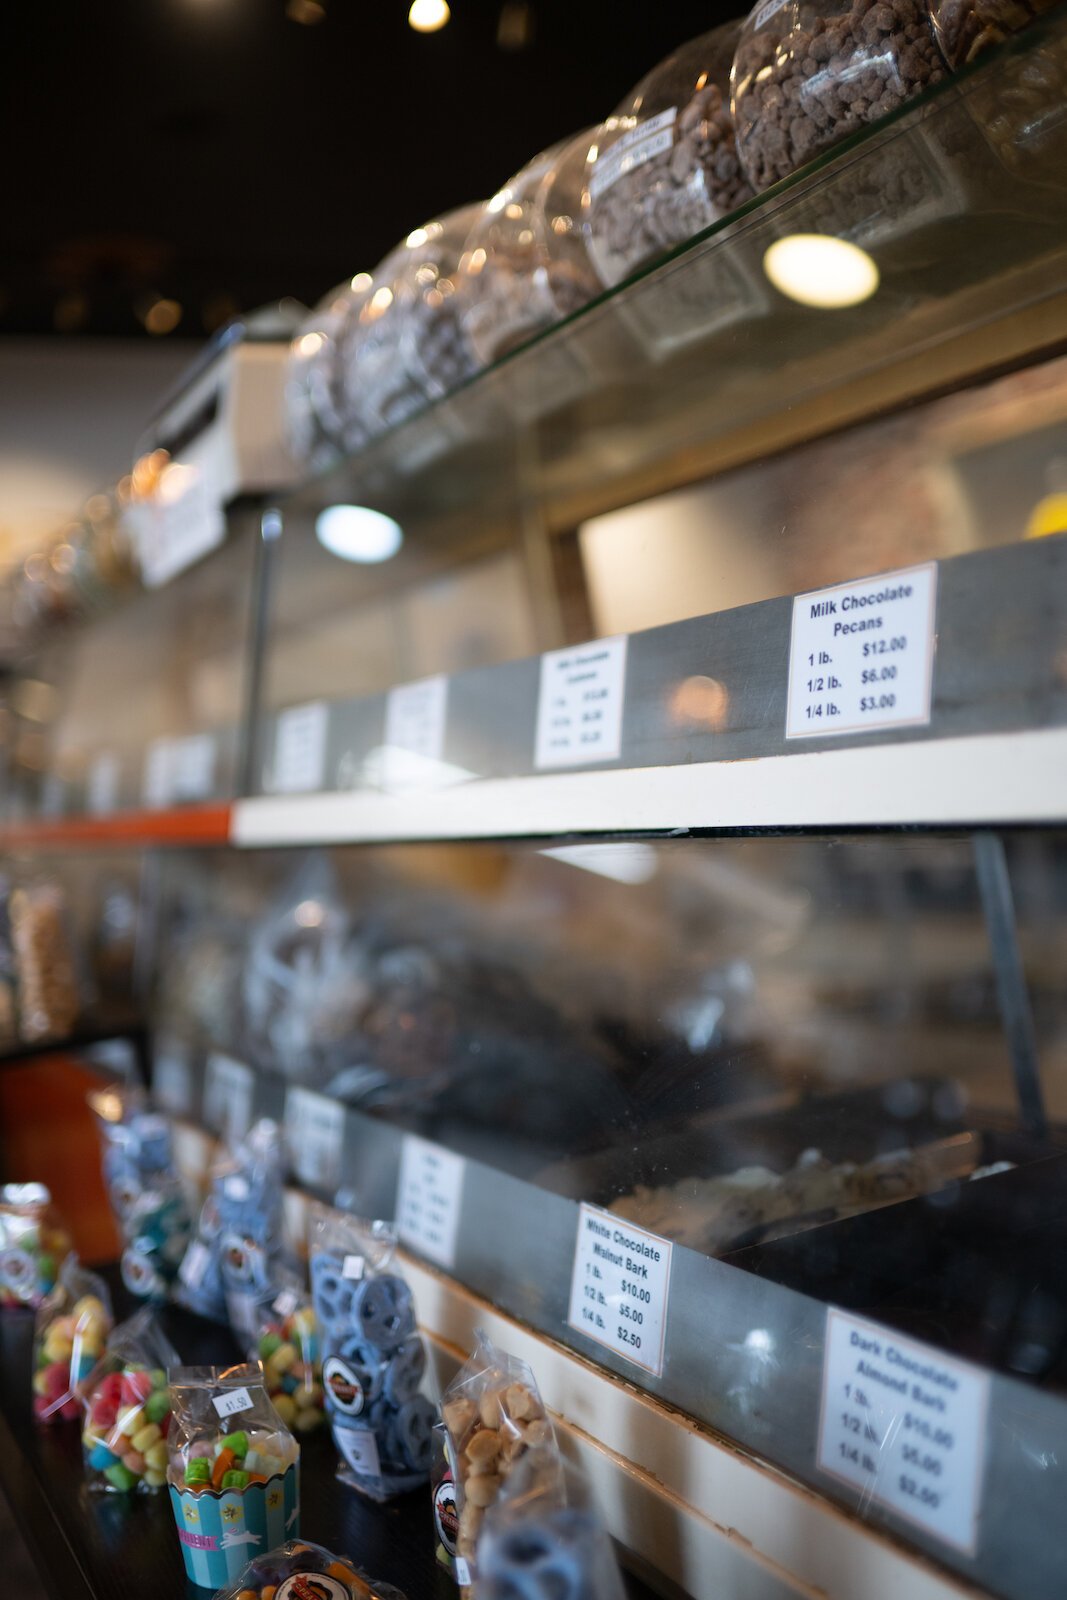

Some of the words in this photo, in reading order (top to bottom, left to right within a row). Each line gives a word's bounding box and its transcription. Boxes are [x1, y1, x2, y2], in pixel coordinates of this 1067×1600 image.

[810, 601, 837, 619] Milk
[841, 585, 913, 612] Chocolate
[833, 616, 883, 637] Pecans
[808, 653, 814, 666] 1
[819, 651, 833, 664] lb.
[862, 636, 907, 657] $12.00
[807, 679, 824, 693] 1/2
[828, 676, 842, 689] lb.
[861, 665, 897, 685] $6.00
[805, 704, 823, 719] 1/4
[826, 703, 841, 716] lb.
[860, 693, 896, 712] $3.00
[586, 1216, 612, 1240] White
[613, 1231, 661, 1263] Chocolate
[593, 1242, 623, 1269] Walnut
[625, 1258, 648, 1280] Bark
[585, 1262, 591, 1275] 1
[593, 1265, 603, 1280] lb.
[621, 1280, 651, 1304] $10.00
[584, 1285, 597, 1301] 1/2
[619, 1304, 643, 1325] $5.00
[582, 1308, 595, 1323] 1/4
[595, 1314, 606, 1329] lb.
[617, 1327, 642, 1349] $2.50
[850, 1331, 881, 1357] Dark
[885, 1346, 958, 1391] Chocolate
[856, 1360, 908, 1395] Almond
[844, 1383, 851, 1399] 1
[841, 1412, 860, 1434] 1/2
[839, 1442, 859, 1463] 1/4
